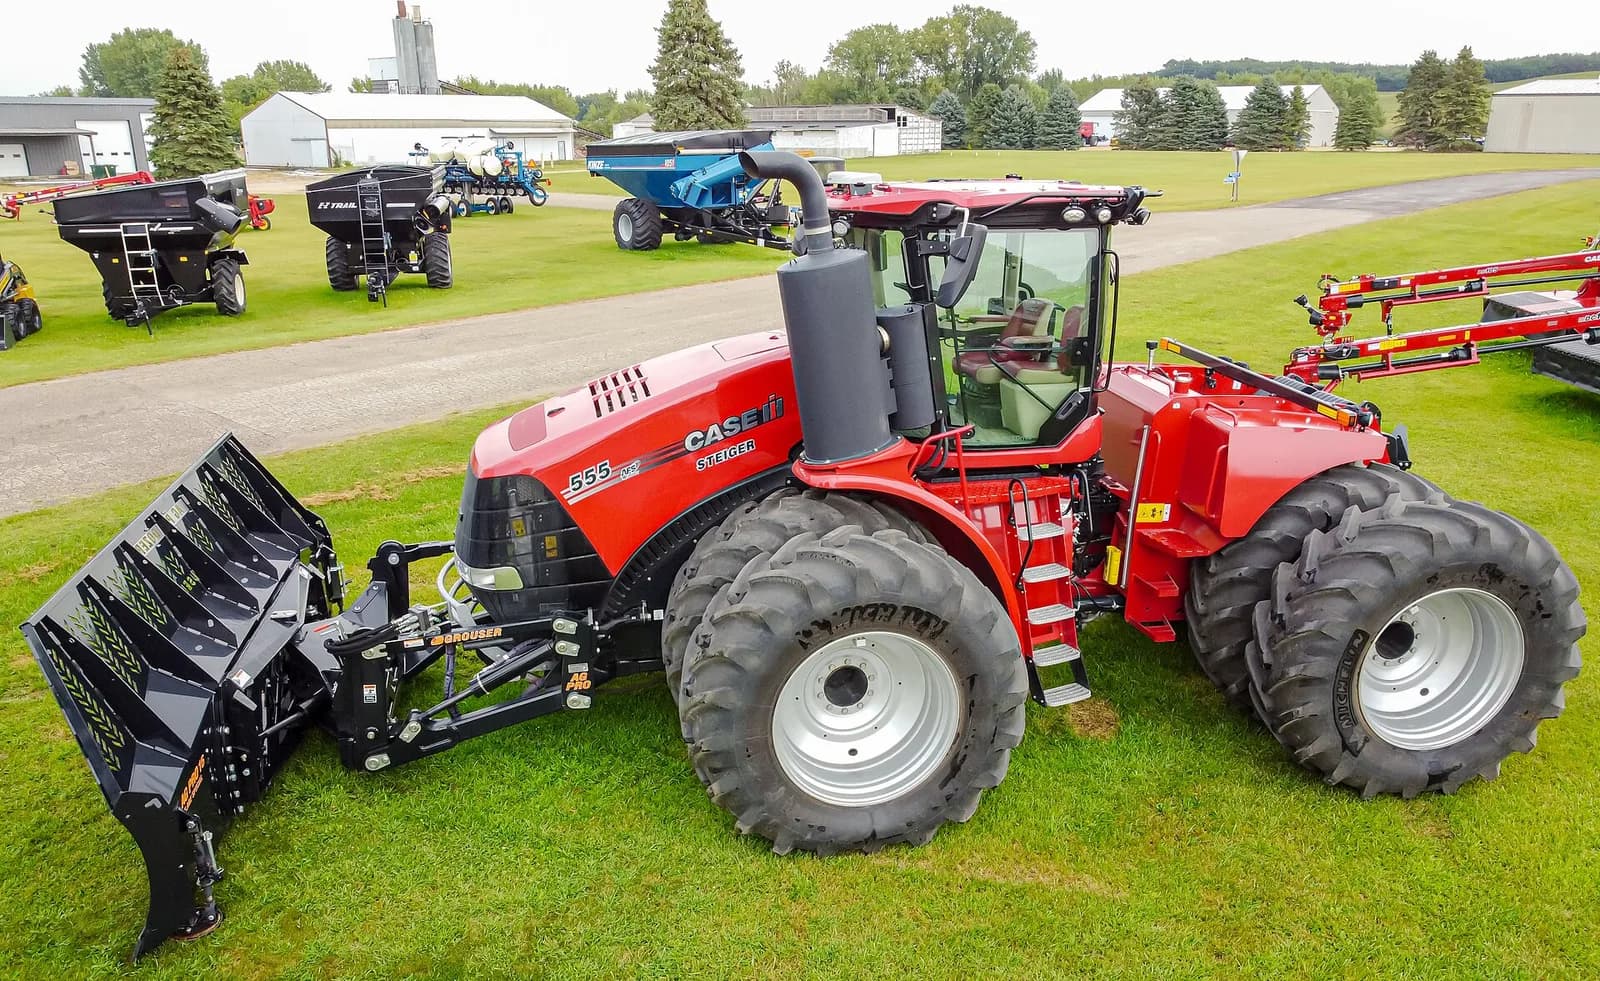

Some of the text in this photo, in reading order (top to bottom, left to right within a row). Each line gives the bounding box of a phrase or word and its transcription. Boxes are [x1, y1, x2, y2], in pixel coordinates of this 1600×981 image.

[588, 160, 604, 169] KINZE
[684, 408, 759, 452] CASE
[696, 439, 756, 471] STEIGER
[569, 460, 612, 492] 555
[444, 627, 502, 643] GROUSER
[565, 680, 591, 691] PRO
[569, 672, 588, 682] AG
[1336, 632, 1364, 729] MICHELIN
